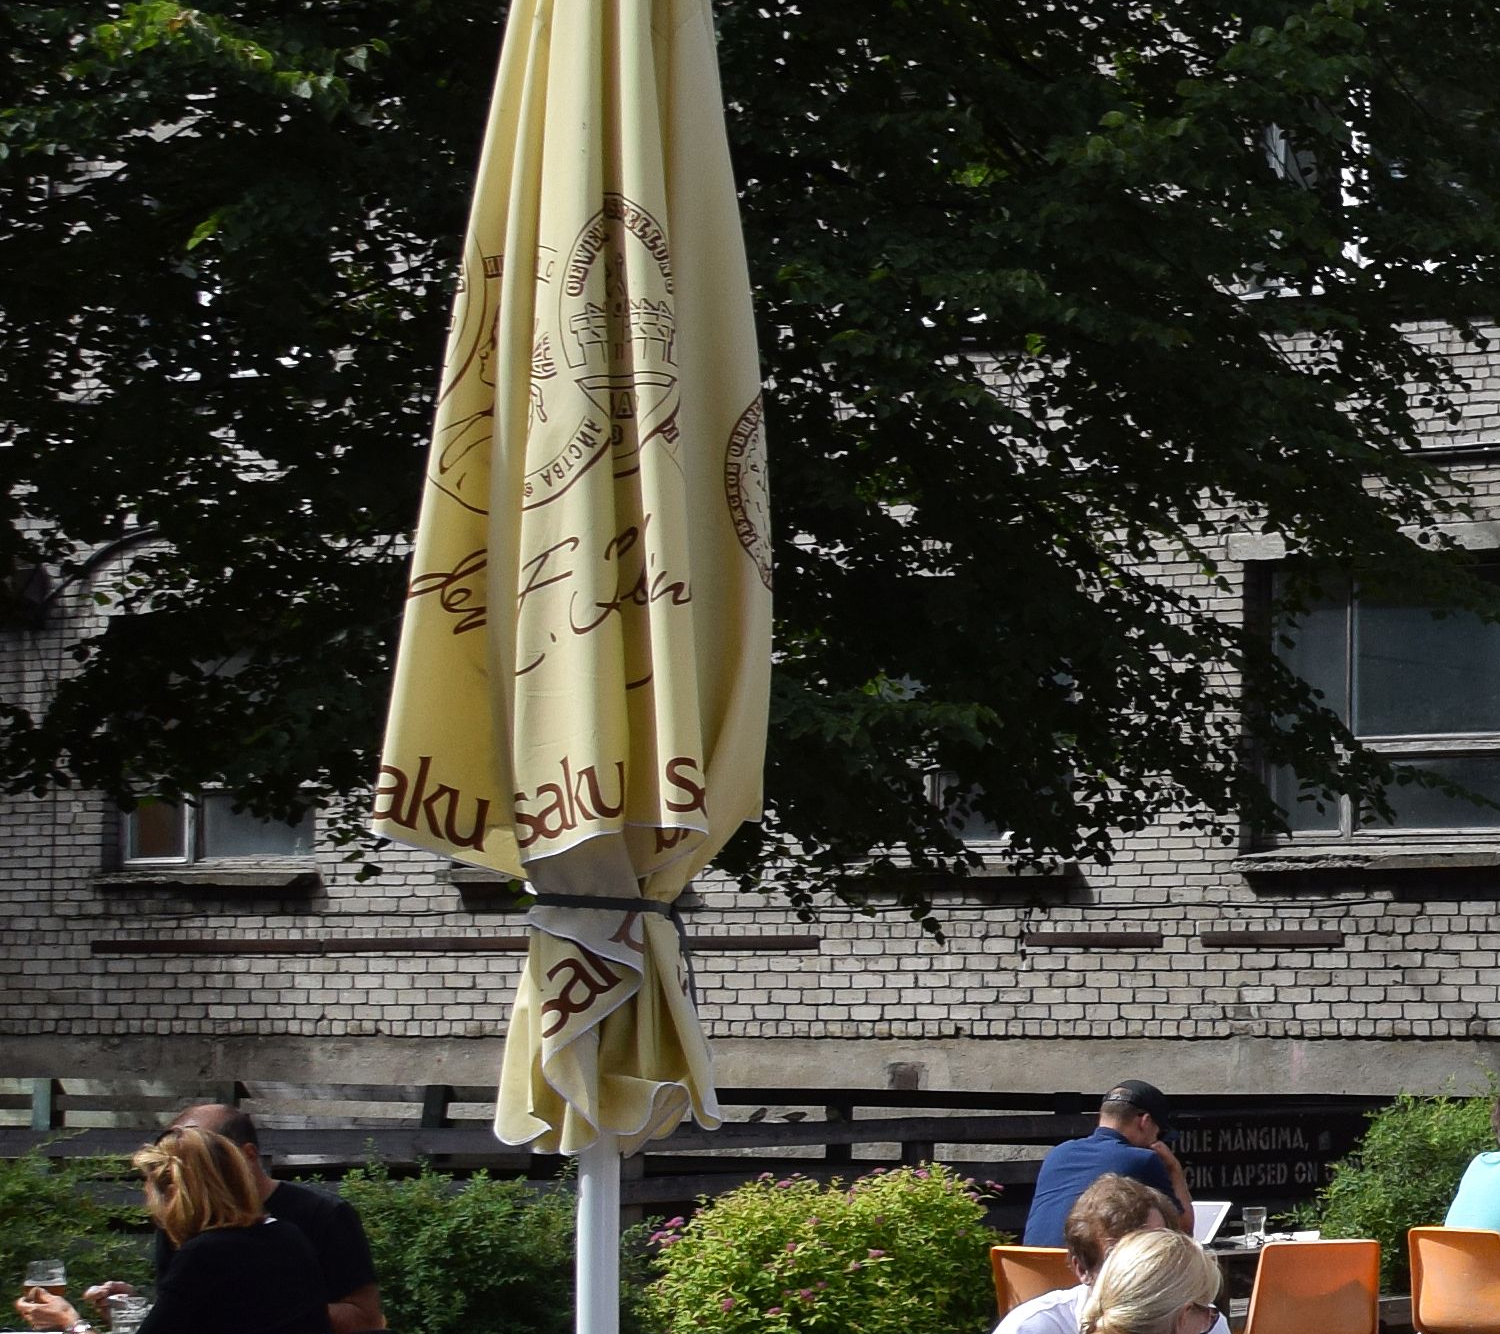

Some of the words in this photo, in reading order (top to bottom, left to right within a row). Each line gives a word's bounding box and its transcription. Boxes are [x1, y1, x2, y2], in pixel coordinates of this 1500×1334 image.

[373, 756, 490, 853] aku
[513, 756, 626, 848] saku
[1222, 1163, 1288, 1187] LAPSED
[1294, 1162, 1319, 1184] ON
